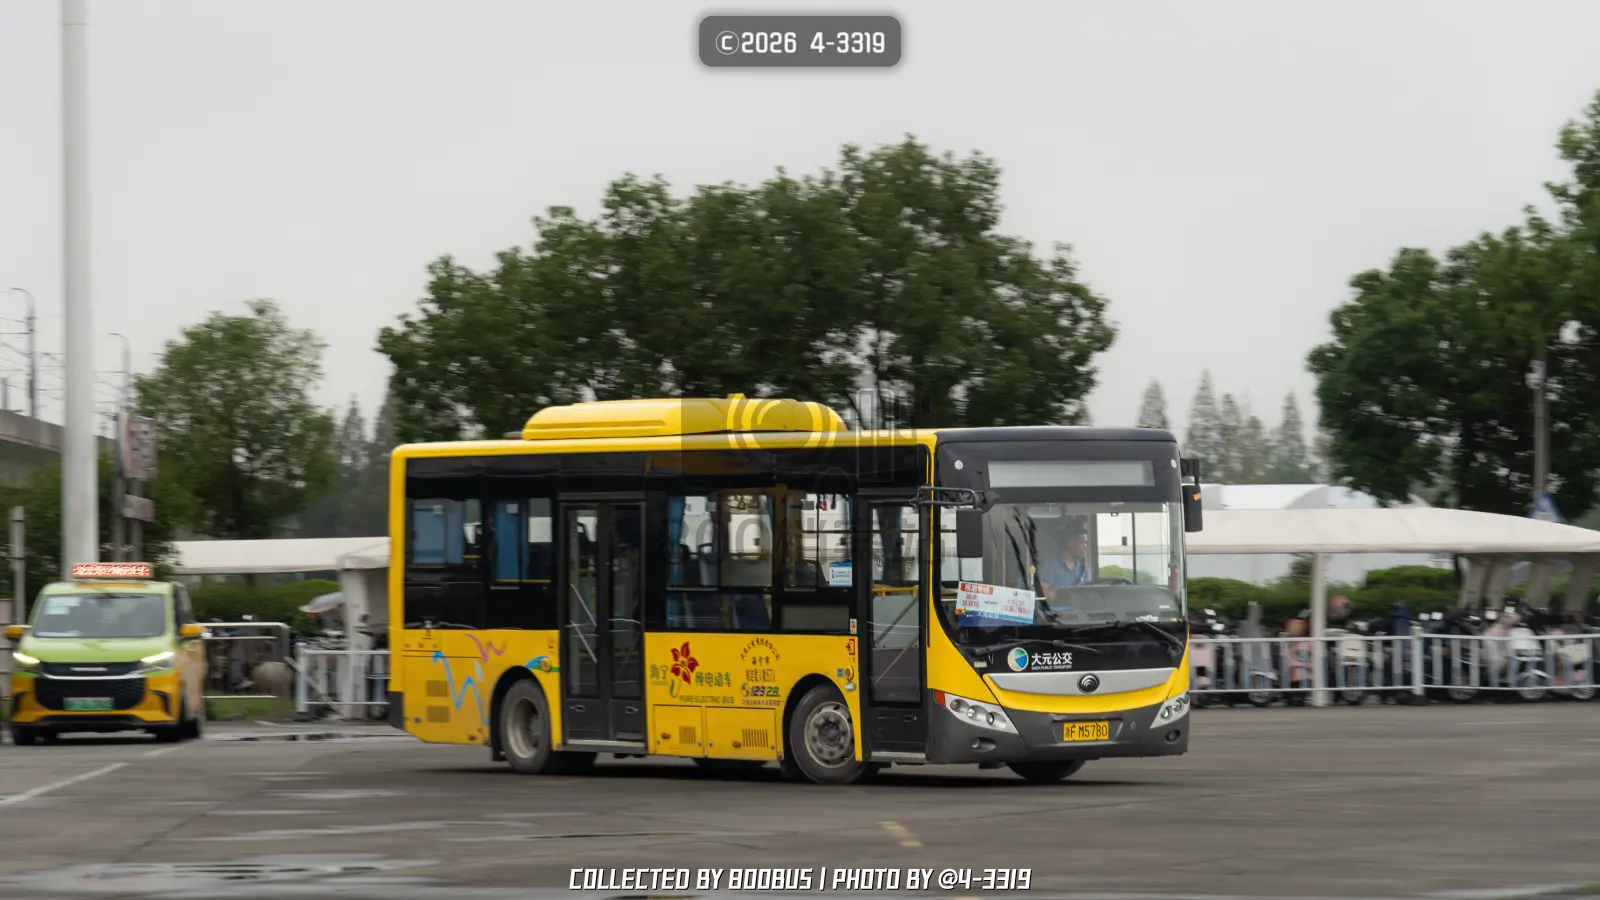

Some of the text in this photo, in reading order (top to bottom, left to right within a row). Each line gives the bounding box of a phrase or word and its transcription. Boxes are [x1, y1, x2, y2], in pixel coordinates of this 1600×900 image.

[1031, 652, 1072, 665] 大元公交
[695, 672, 732, 687] 纯电动车
[695, 695, 720, 703] ELECTRIC
[722, 696, 735, 704] BUS
[1078, 724, 1108, 738] M5780
